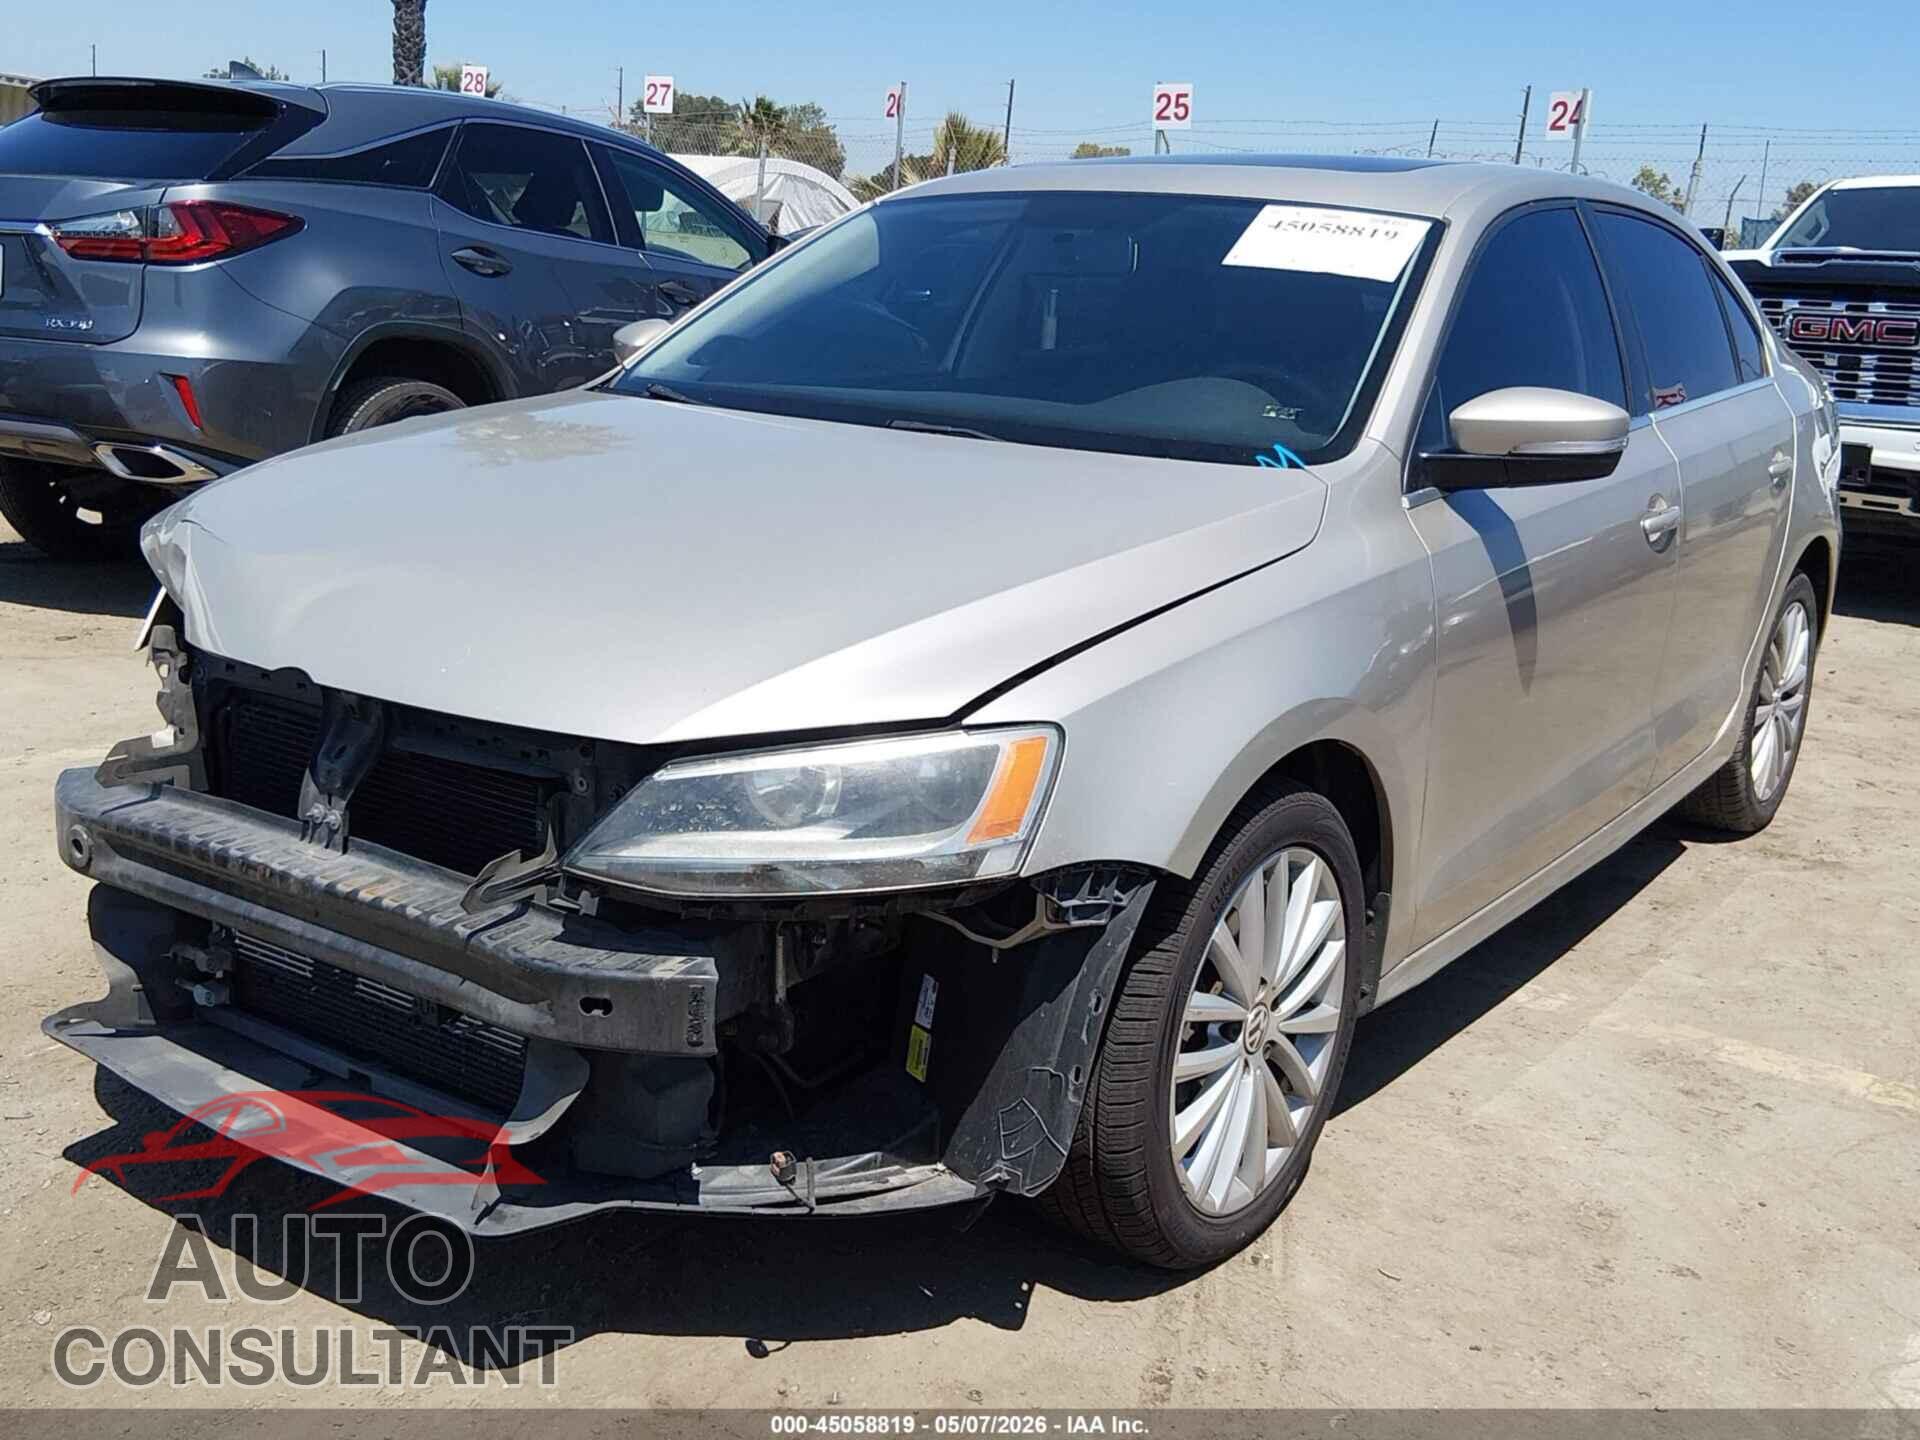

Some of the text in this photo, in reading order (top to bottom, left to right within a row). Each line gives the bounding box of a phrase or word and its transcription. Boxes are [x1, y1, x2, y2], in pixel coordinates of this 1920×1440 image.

[464, 72, 485, 93] 28
[646, 83, 671, 106] 27
[1156, 93, 1189, 121] 25
[1792, 316, 1918, 344] GMC
